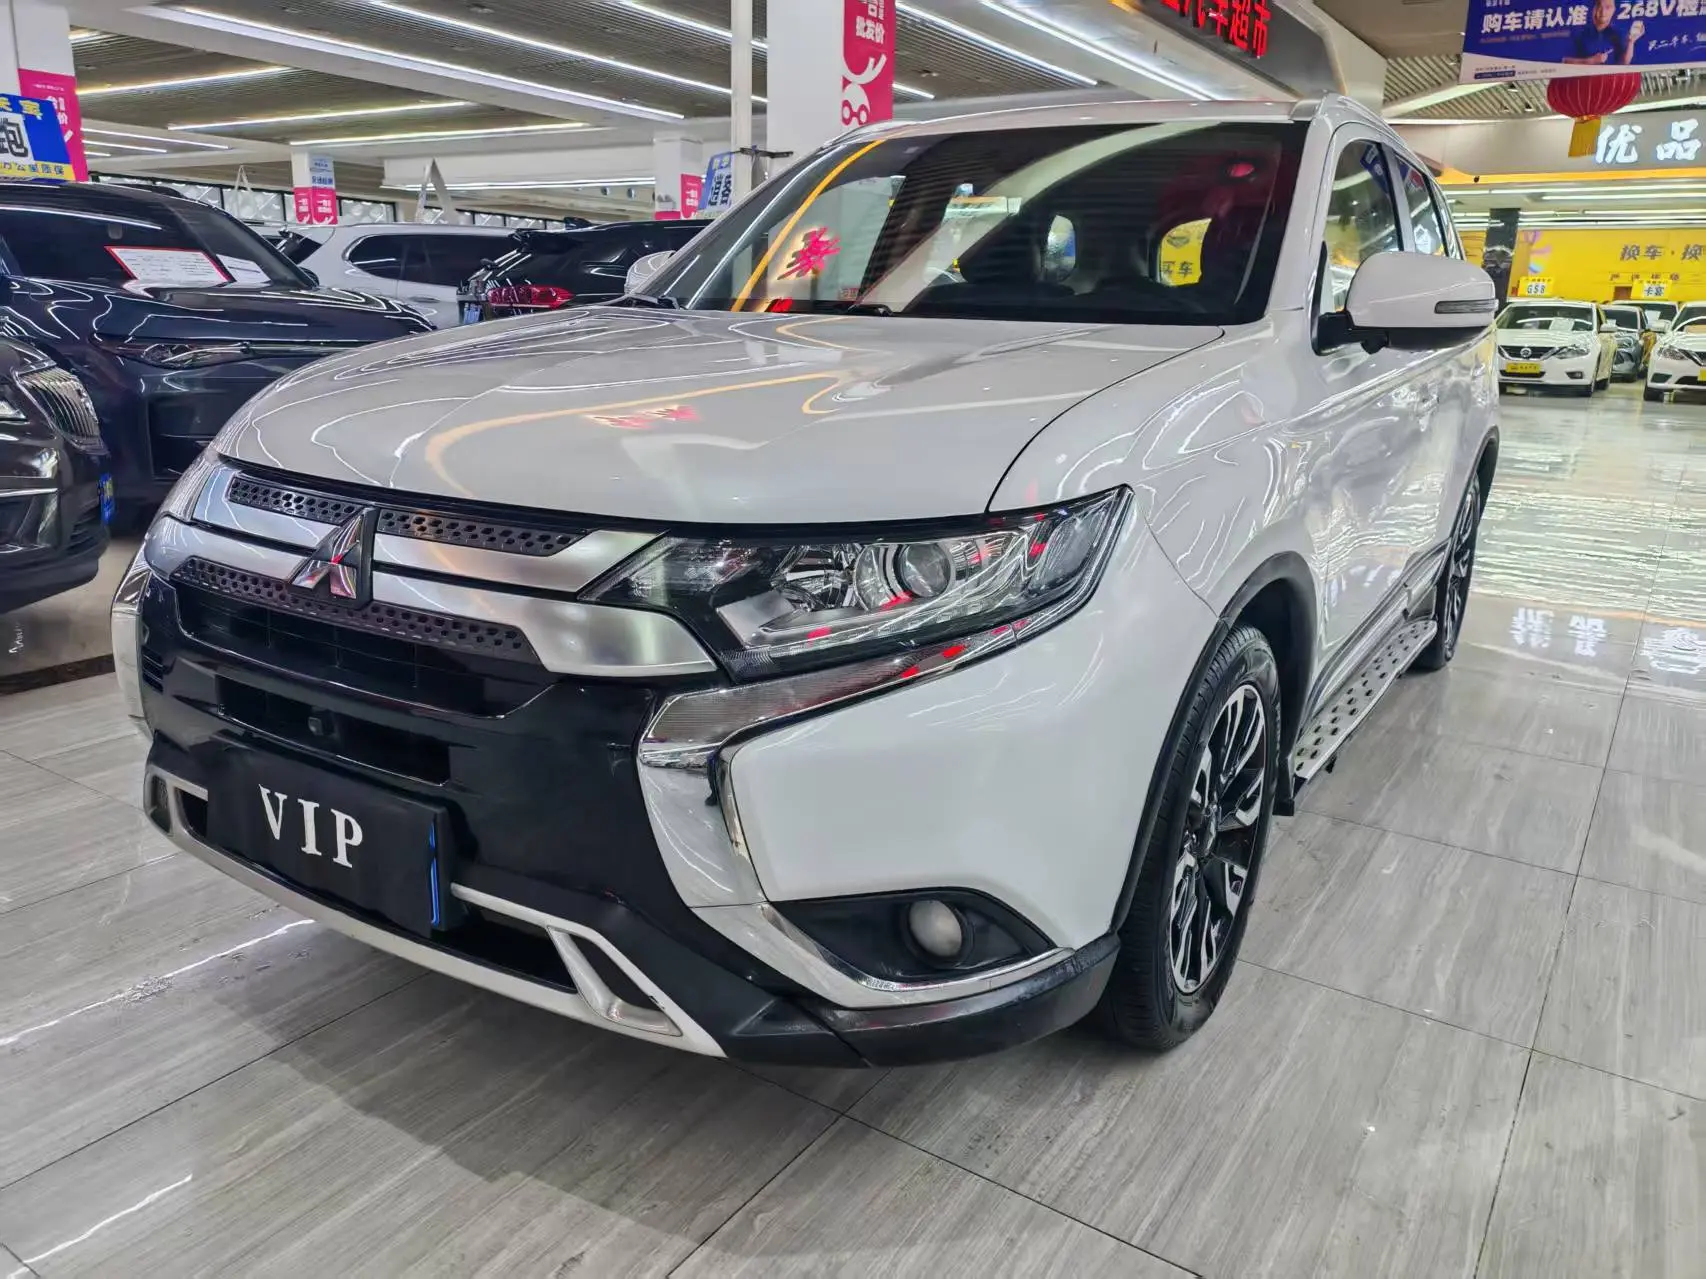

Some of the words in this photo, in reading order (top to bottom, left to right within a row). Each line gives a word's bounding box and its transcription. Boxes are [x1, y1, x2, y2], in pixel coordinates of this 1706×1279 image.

[855, 15, 885, 45] 批发价
[1481, 4, 1589, 34] 购车请认准
[1595, 118, 1702, 164] 优品
[258, 783, 364, 869] VIP
